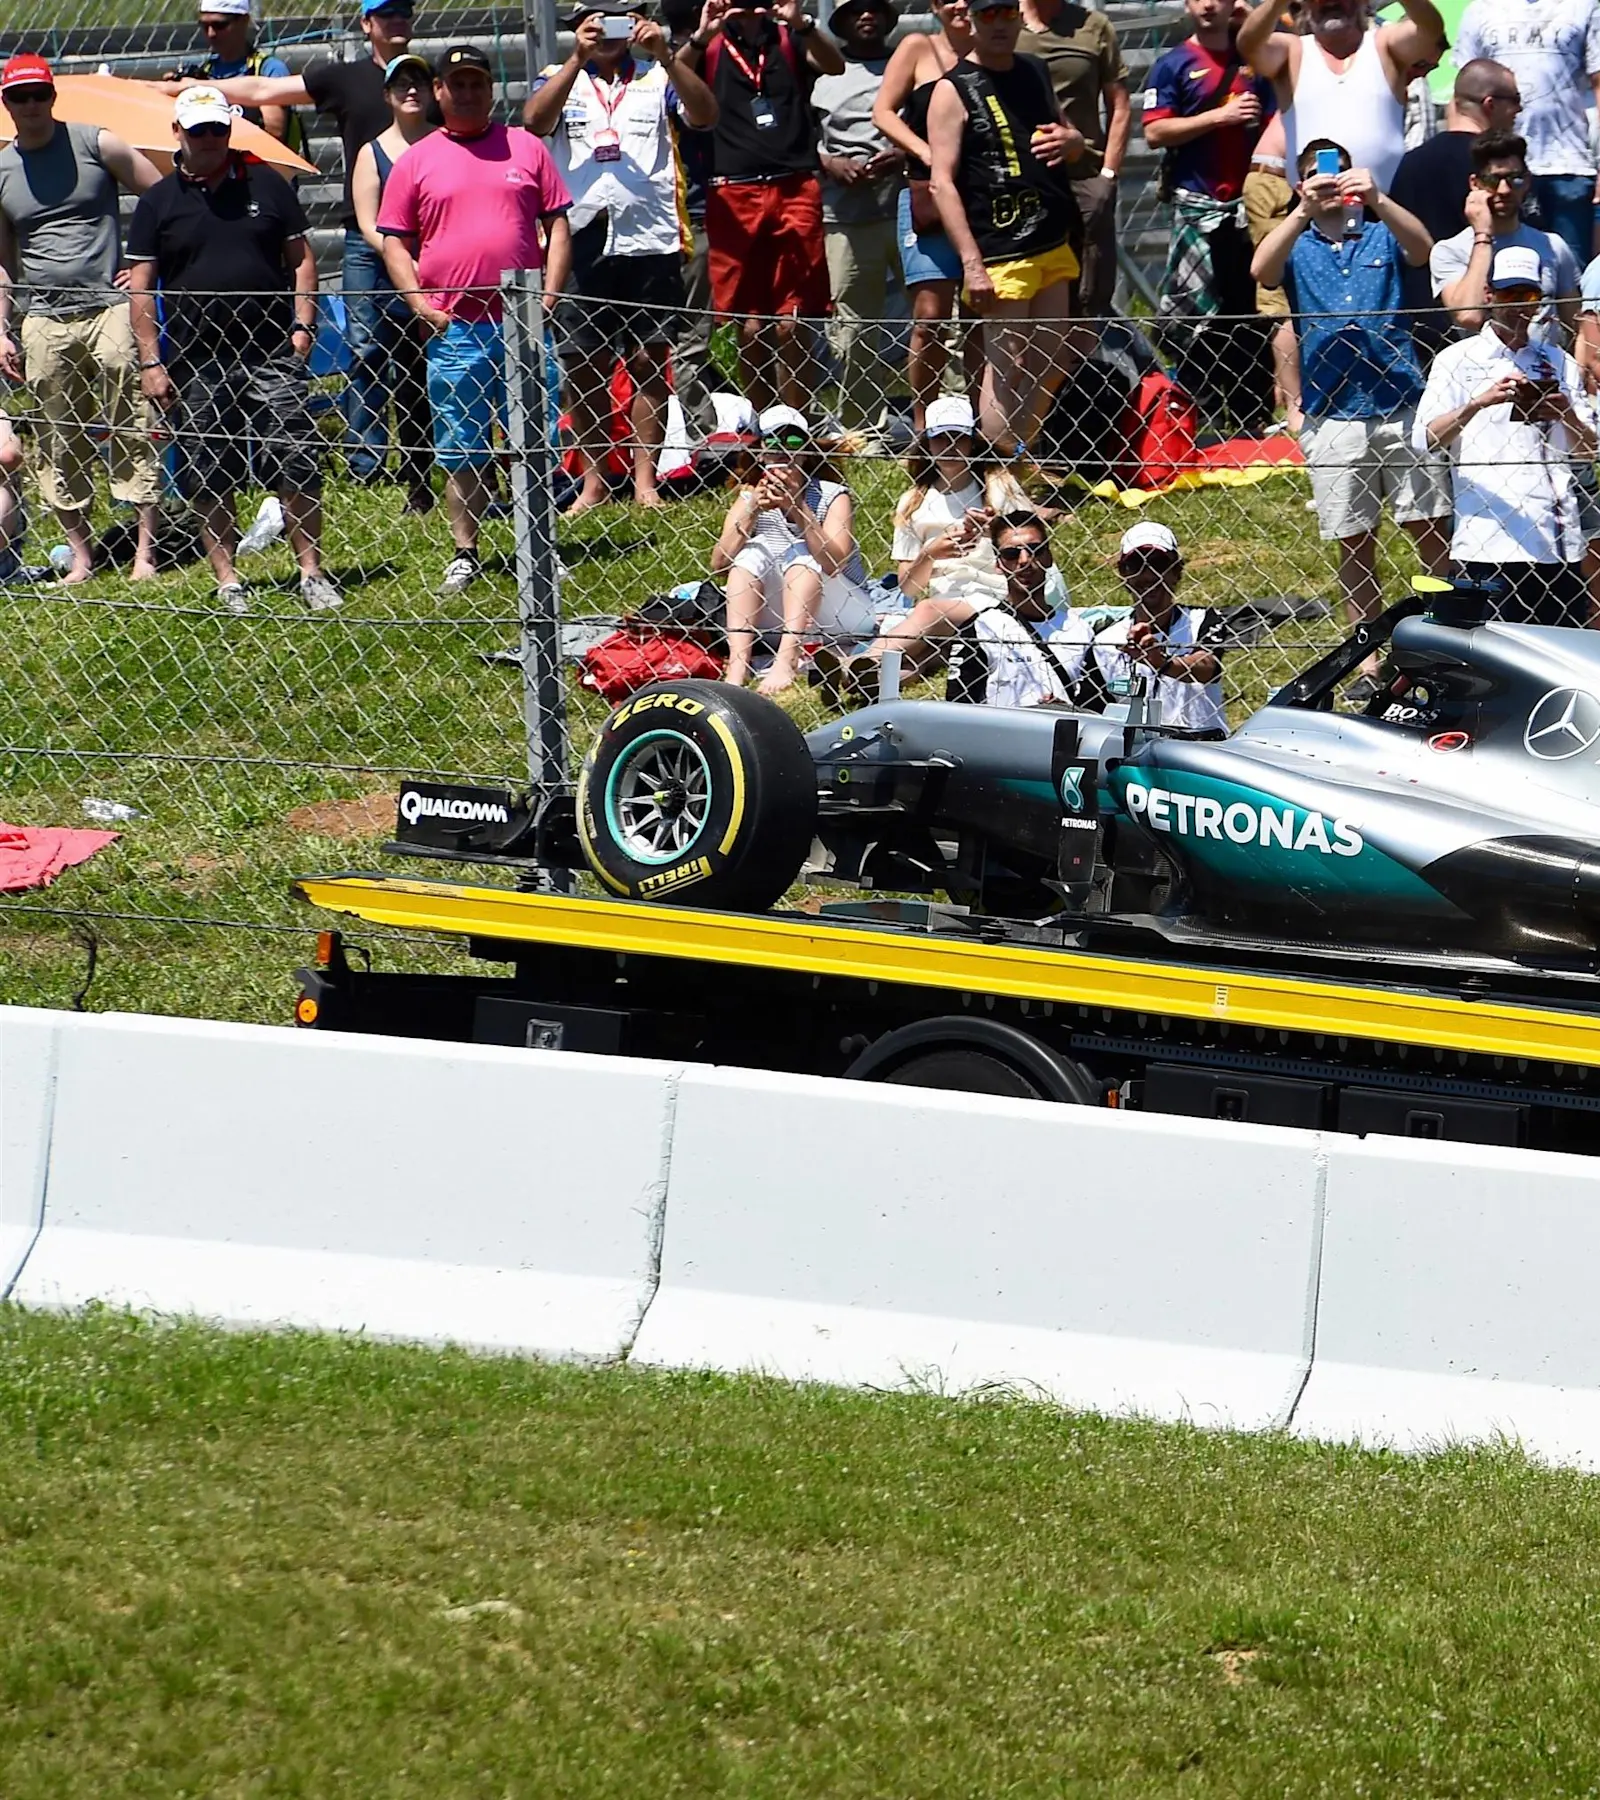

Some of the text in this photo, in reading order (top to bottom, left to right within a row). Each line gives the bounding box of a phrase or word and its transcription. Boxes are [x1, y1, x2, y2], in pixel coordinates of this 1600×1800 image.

[611, 693, 705, 731] ZERO
[1383, 703, 1441, 721] BOSS
[400, 791, 508, 825] QUALCOMM
[1061, 817, 1097, 830] PETRONAS
[1126, 783, 1364, 857] PETRONAS
[637, 856, 713, 900] PIRELLI
